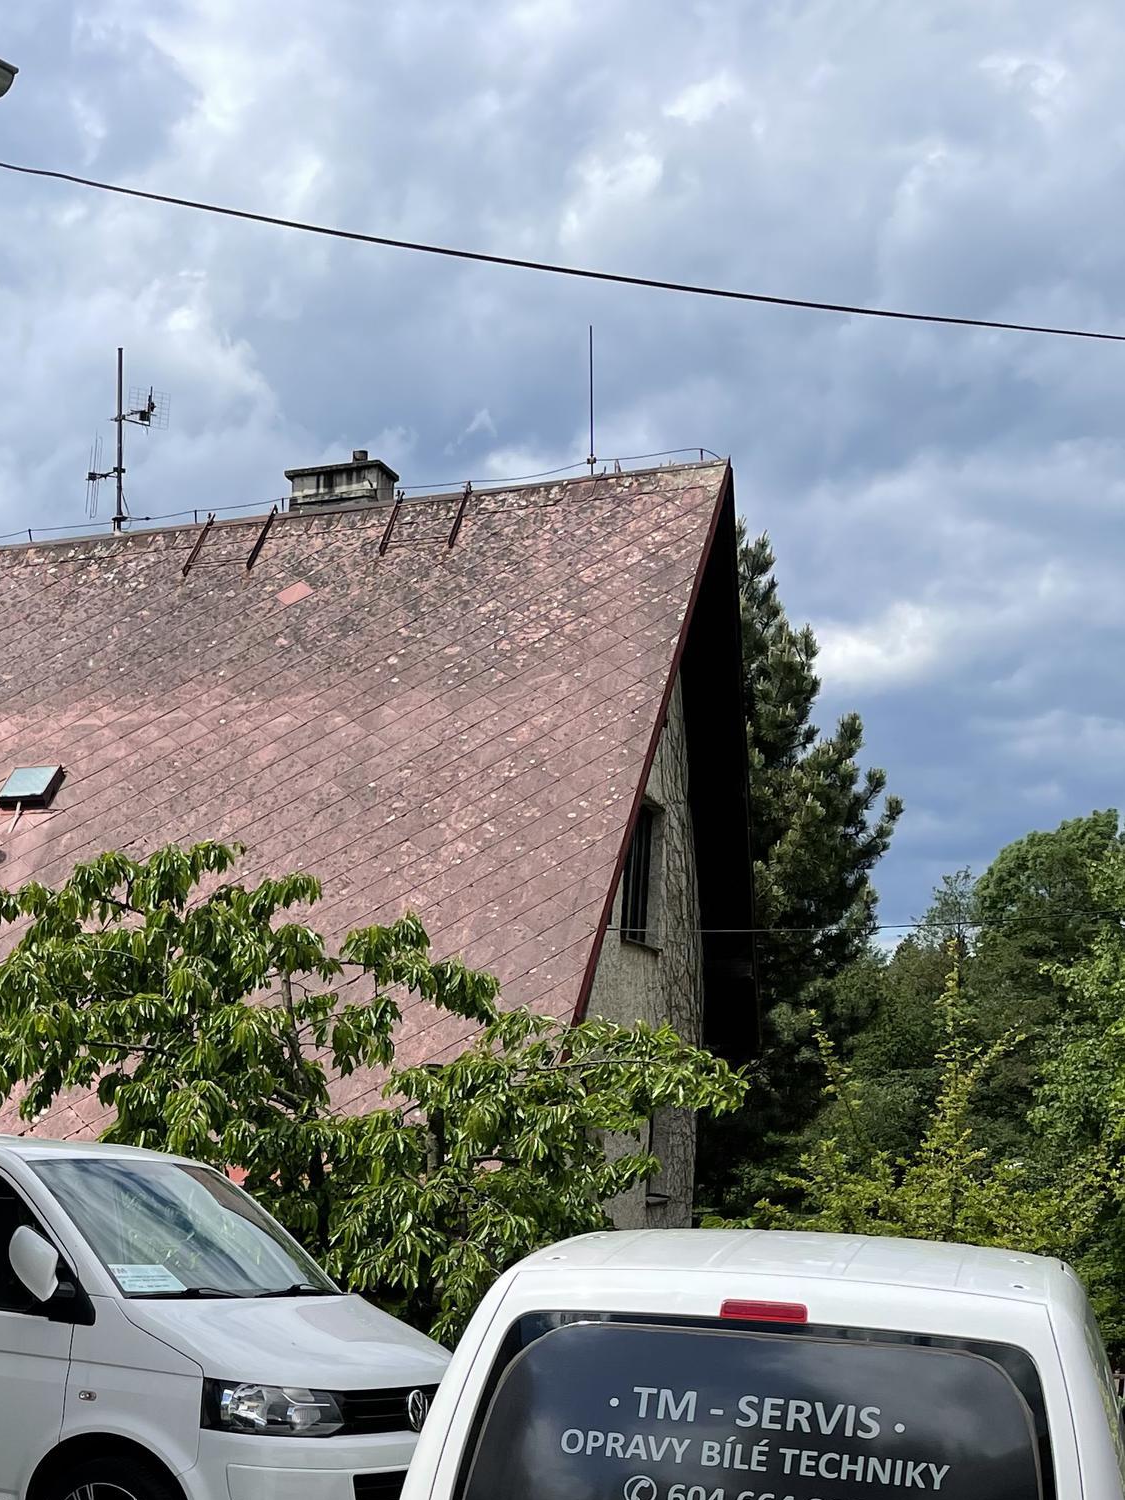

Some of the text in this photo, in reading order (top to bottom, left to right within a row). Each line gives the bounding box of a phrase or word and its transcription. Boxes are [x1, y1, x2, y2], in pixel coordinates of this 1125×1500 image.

[633, 1386, 698, 1423] TM
[735, 1395, 882, 1440] SERVIS
[560, 1428, 951, 1490] OPRAVY BÍLÉ TECHNIKY
